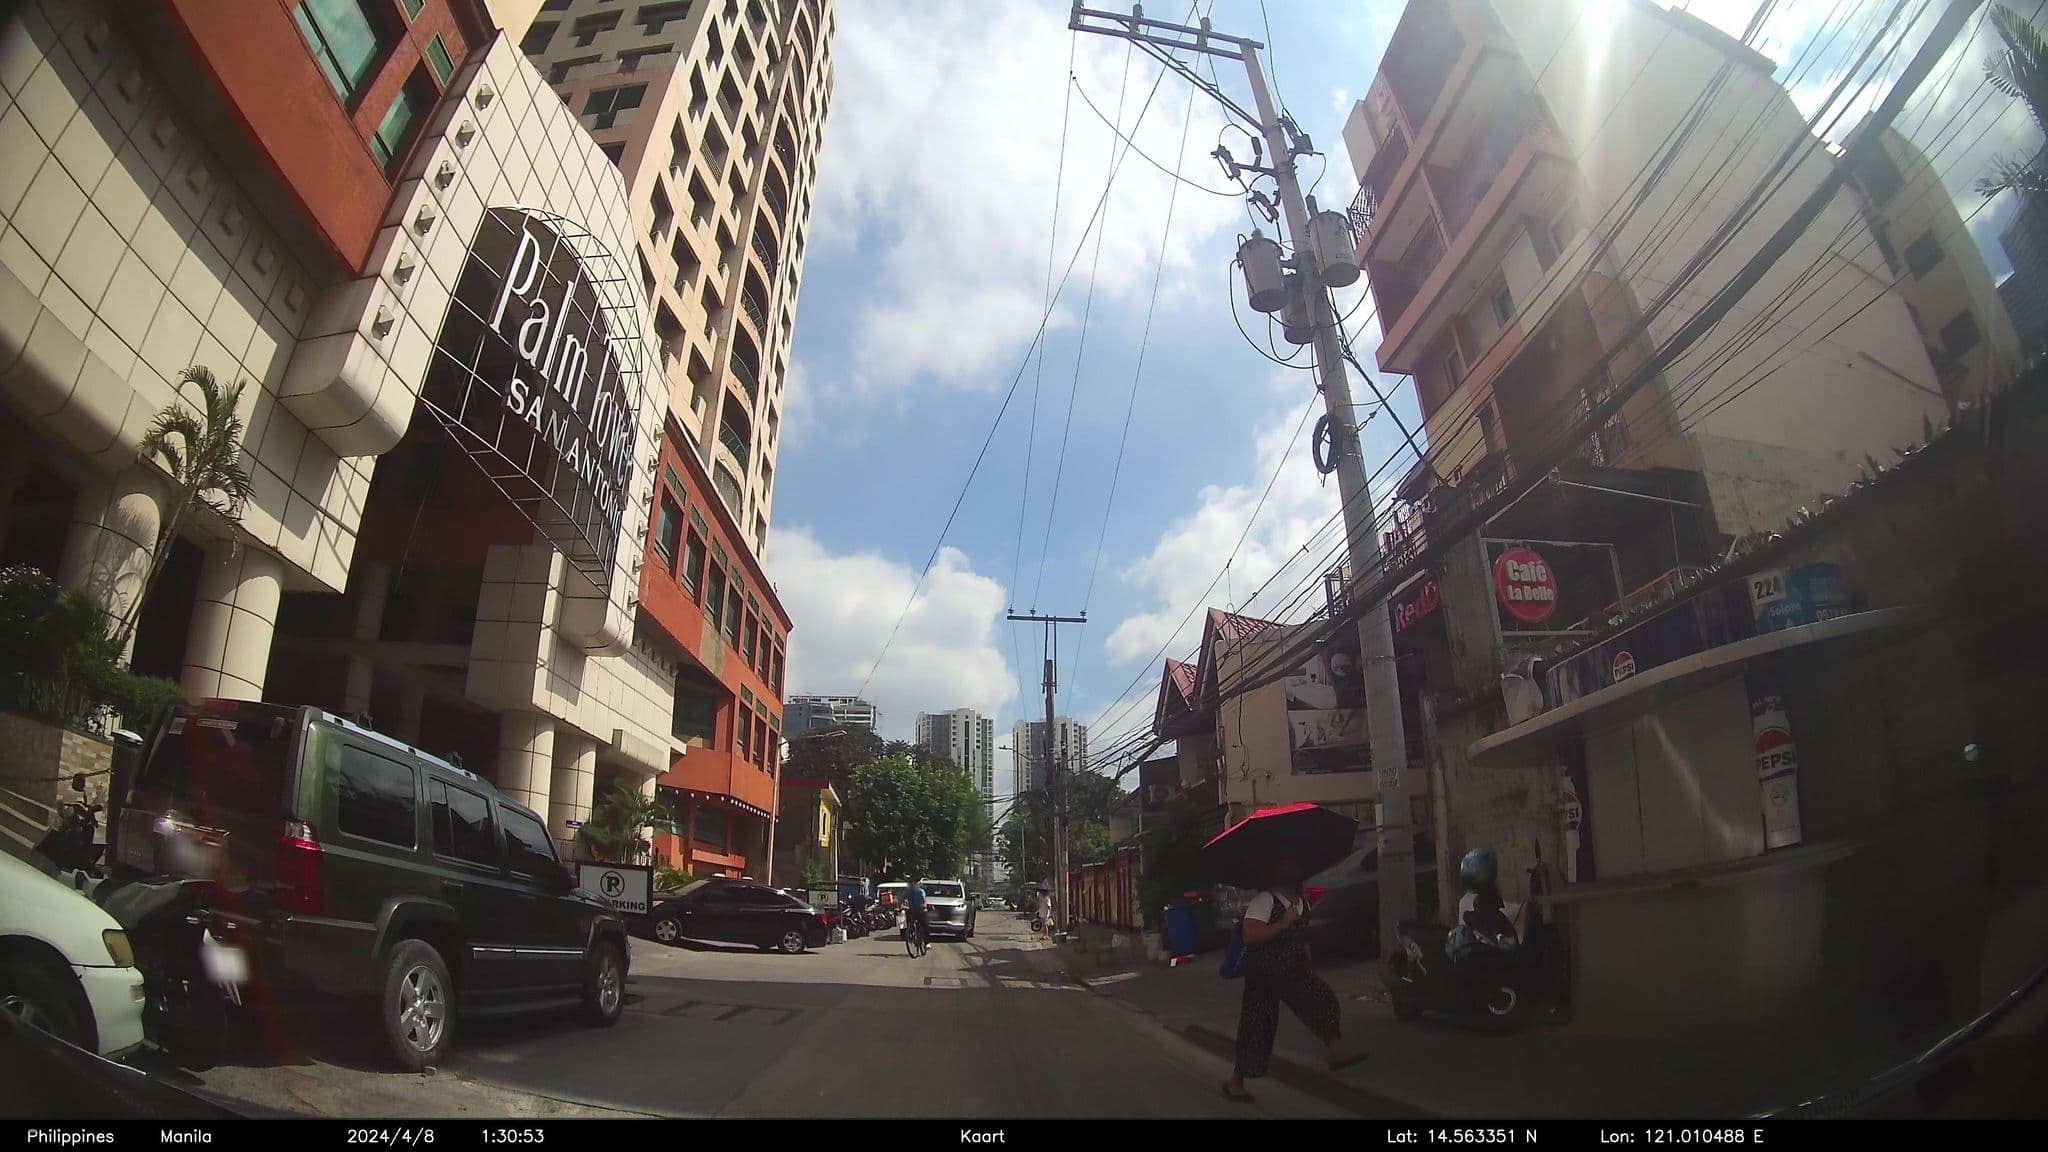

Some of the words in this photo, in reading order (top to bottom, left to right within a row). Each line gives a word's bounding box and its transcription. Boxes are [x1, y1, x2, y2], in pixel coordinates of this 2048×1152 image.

[488, 222, 590, 410] Palm
[506, 377, 570, 449] SAN
[1506, 559, 1547, 583] Café
[1507, 585, 1523, 601] La
[1523, 585, 1554, 601] Belle
[1614, 662, 1634, 678] PEPSI
[611, 900, 646, 911] RKING
